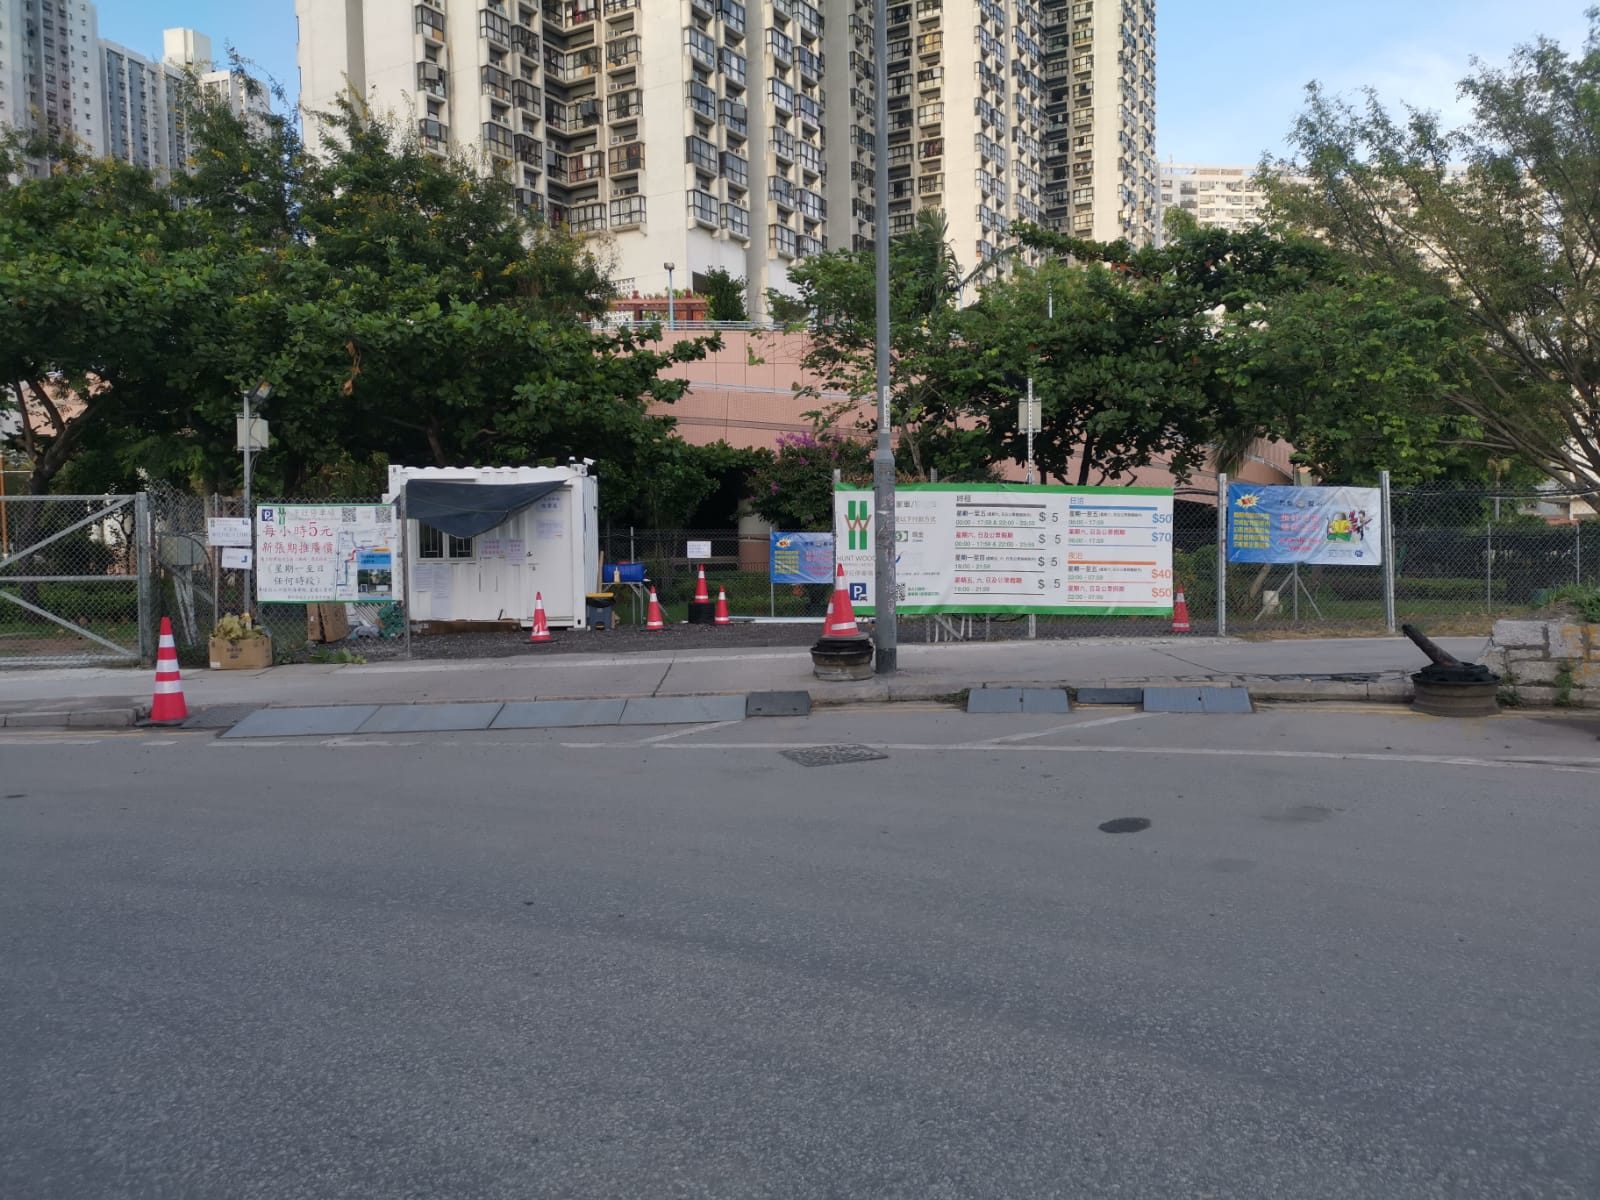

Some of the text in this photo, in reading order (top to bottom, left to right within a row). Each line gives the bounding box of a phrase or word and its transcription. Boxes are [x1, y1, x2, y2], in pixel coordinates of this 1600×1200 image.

[1151, 512, 1172, 524] $50
[262, 521, 334, 538] 每小時5元
[1151, 531, 1172, 543] $70
[261, 541, 334, 555] 新張期推廣價
[1151, 568, 1172, 580] $40
[1151, 587, 1172, 598] $50
